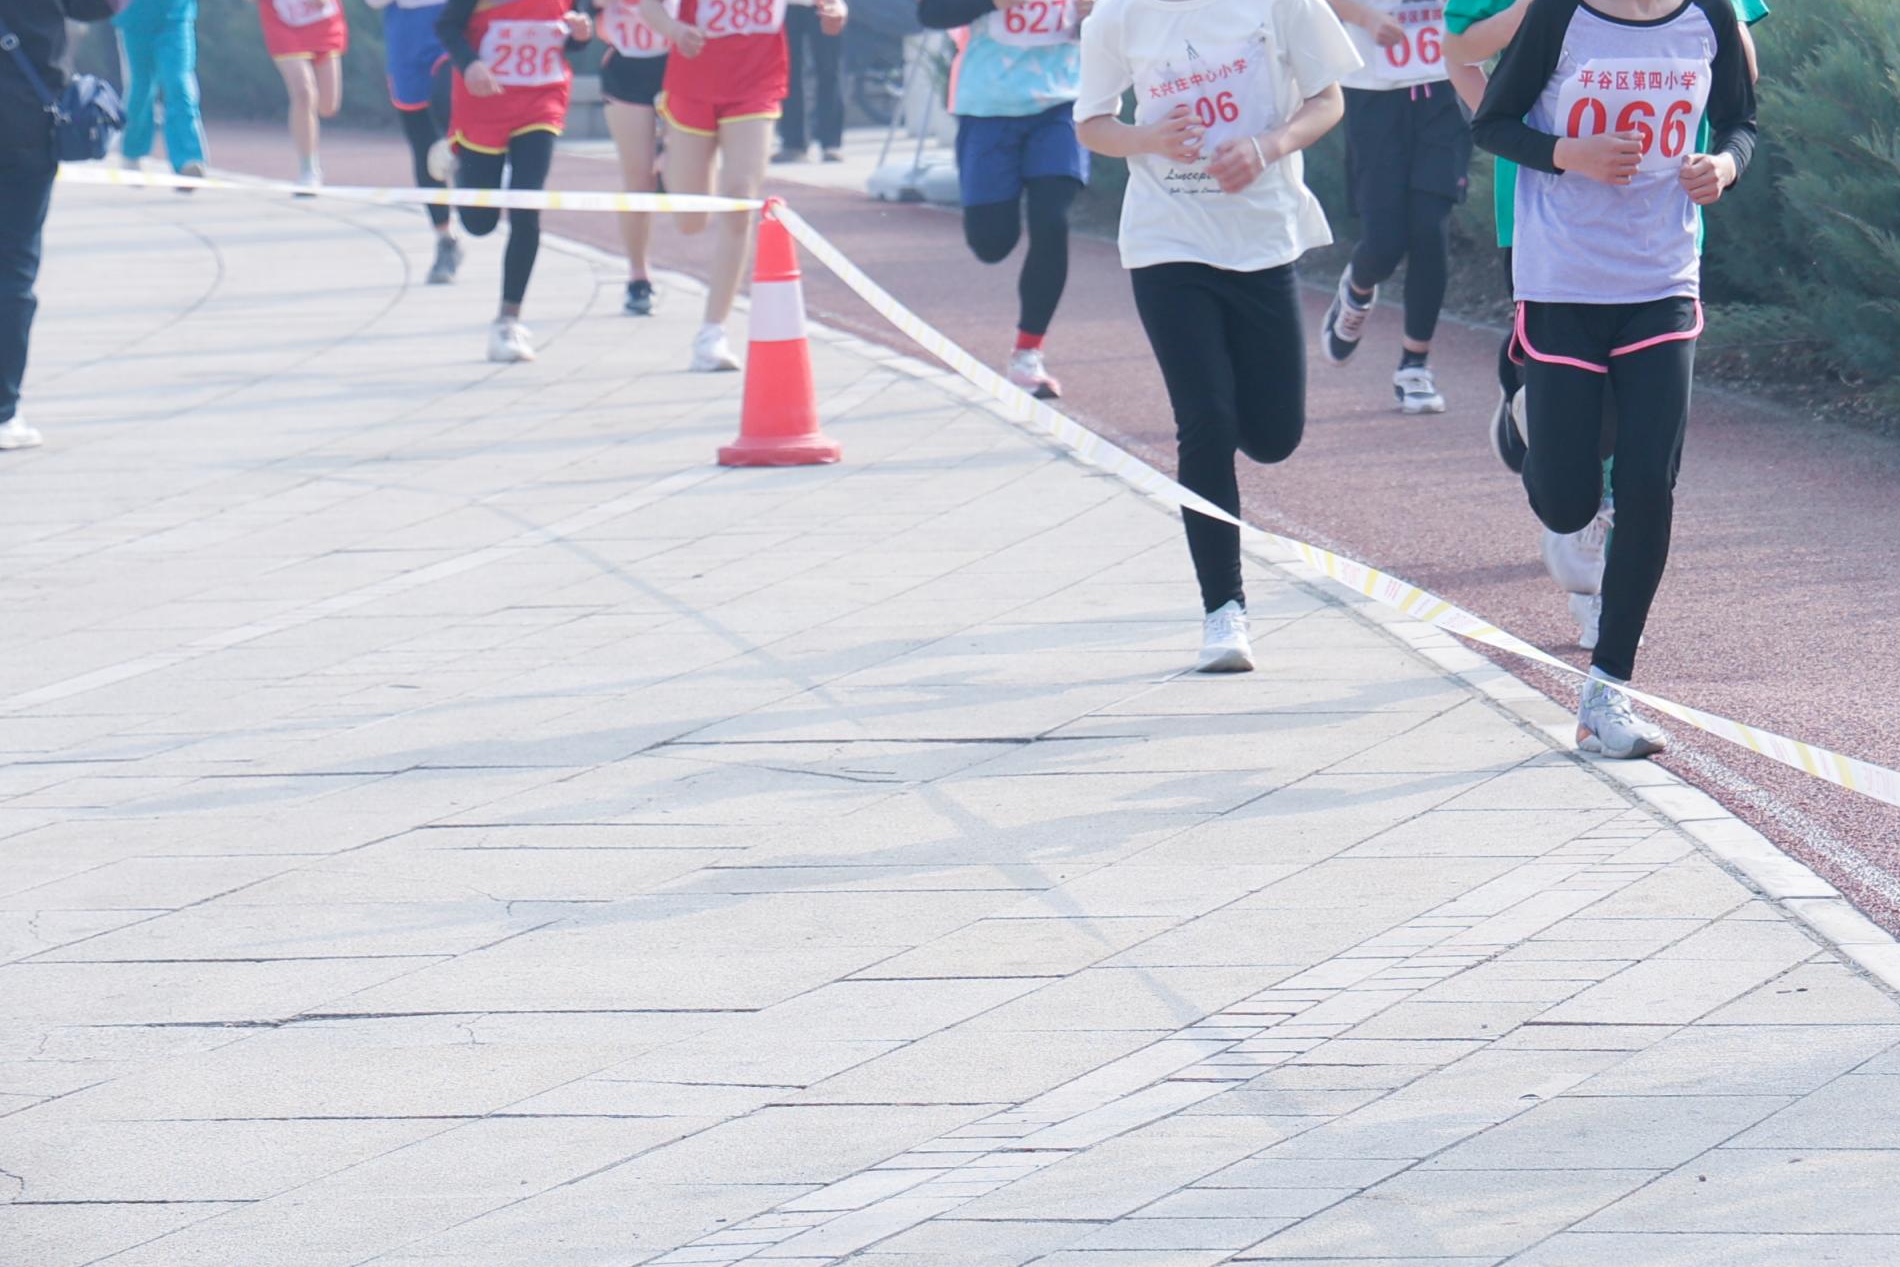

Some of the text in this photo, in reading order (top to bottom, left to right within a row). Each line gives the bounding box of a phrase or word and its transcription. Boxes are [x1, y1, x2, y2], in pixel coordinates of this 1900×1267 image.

[1577, 69, 1697, 92] 平谷区第四小学
[1566, 96, 1693, 159] 066
